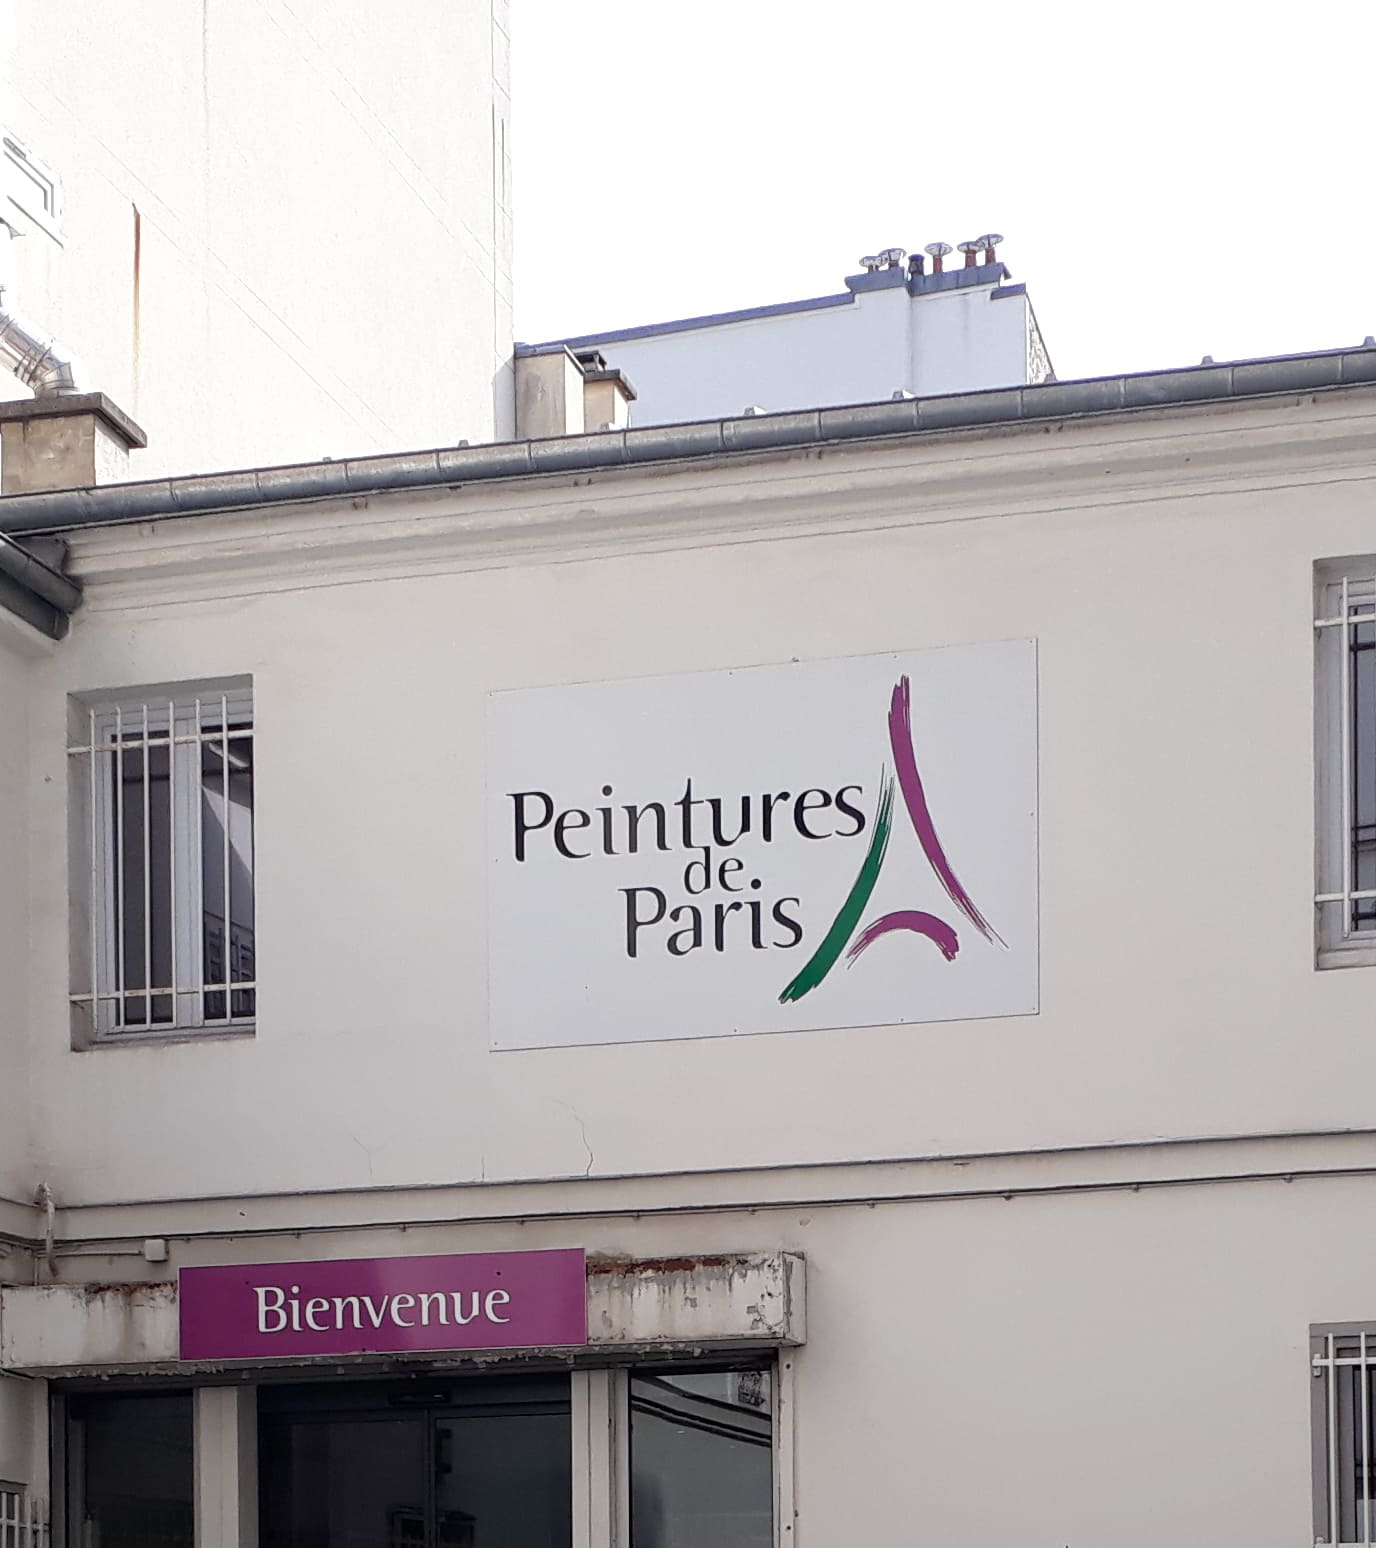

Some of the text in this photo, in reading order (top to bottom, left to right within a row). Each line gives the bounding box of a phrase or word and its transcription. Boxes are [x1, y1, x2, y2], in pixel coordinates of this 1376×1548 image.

[506, 778, 866, 863] Peintures
[683, 846, 745, 895] de
[617, 879, 803, 958] Paris
[252, 1284, 512, 1334] Bienvenue
